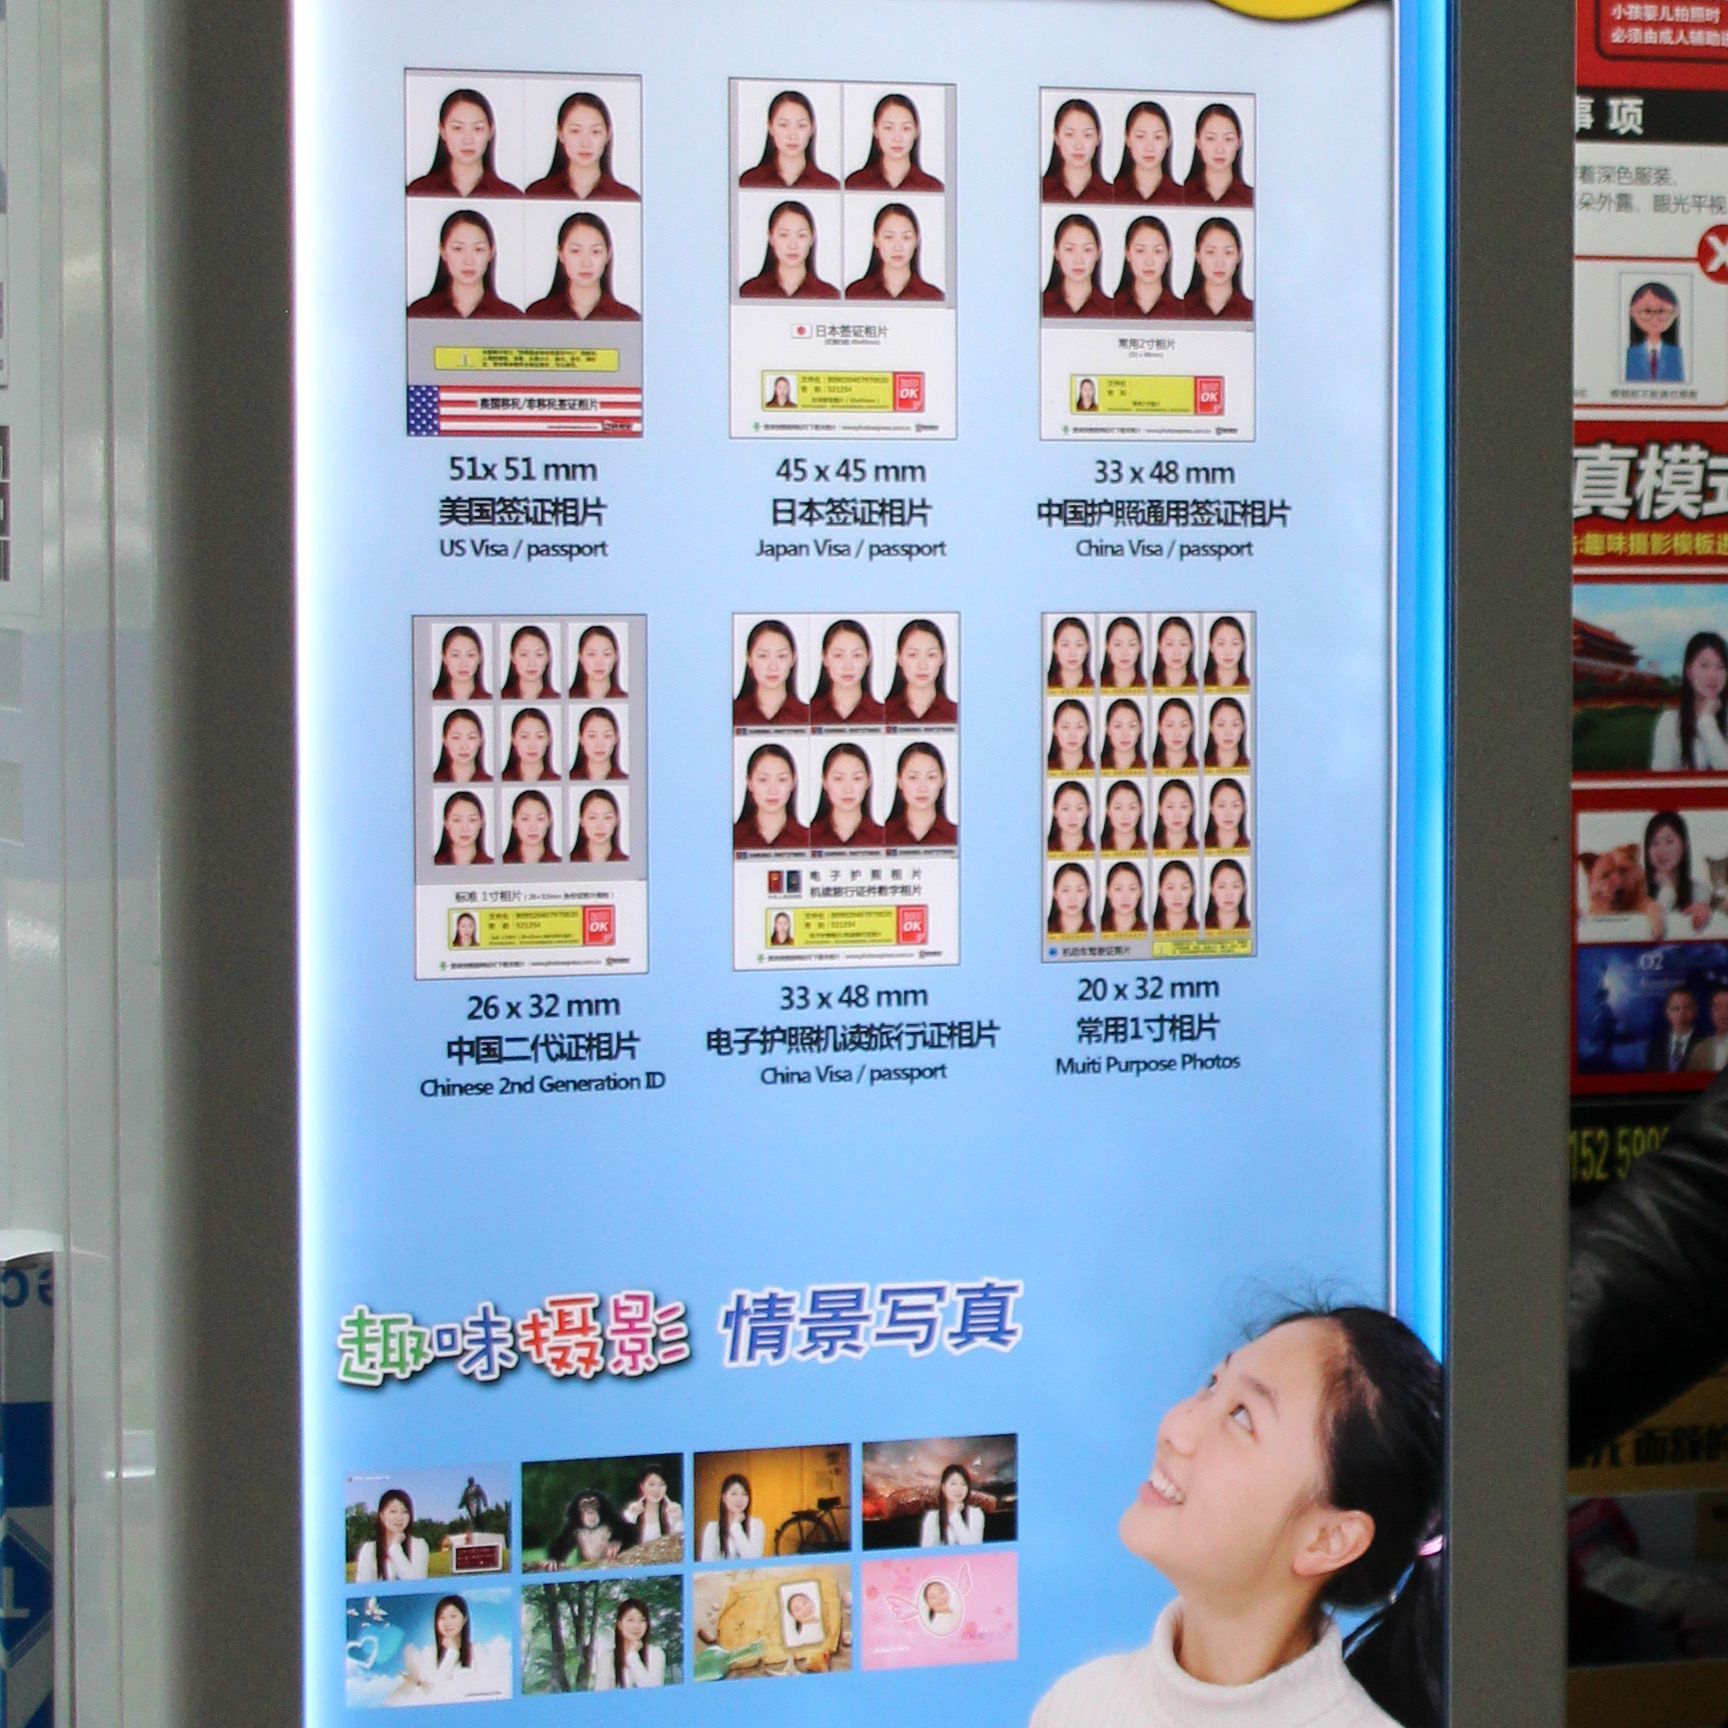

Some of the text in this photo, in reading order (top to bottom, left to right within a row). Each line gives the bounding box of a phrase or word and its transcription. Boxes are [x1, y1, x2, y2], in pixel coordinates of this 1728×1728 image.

[505, 456, 536, 482] 51
[544, 461, 598, 482] mm
[776, 459, 926, 483] 45 x 45 mm
[1094, 460, 1236, 484] 33 x 48 mm
[439, 496, 607, 528] 美国签证相片
[771, 497, 933, 528] 日本签证相片
[1037, 498, 1292, 528] 中国护照通用签证相片
[440, 539, 466, 558] US
[470, 539, 509, 558] Visa
[527, 539, 609, 562] passport
[755, 538, 809, 561] Japan
[813, 539, 852, 558] Visa
[868, 539, 947, 562] passport
[1075, 538, 1125, 558] China
[1128, 538, 1163, 558] Visa
[1179, 539, 1254, 562] passport
[780, 983, 928, 1012] 33 x 48 mm
[1077, 976, 1220, 1002] 20 x 32 mm
[467, 994, 620, 1021] 26 x 32 mm
[706, 1018, 1000, 1057] 电子护照机读旅行证相片
[1077, 1012, 1221, 1046] 常用1寸相片
[446, 1032, 640, 1066] 中国二代证相片
[760, 1066, 811, 1086] China
[815, 1065, 853, 1084] Visa
[869, 1061, 948, 1086] passport
[1106, 1054, 1177, 1077] Purpose
[1182, 1052, 1241, 1071] Photos
[420, 1071, 667, 1098] Chinese 2nd Generation ID
[338, 1277, 1023, 1386] 趣味摄影 情景写真
